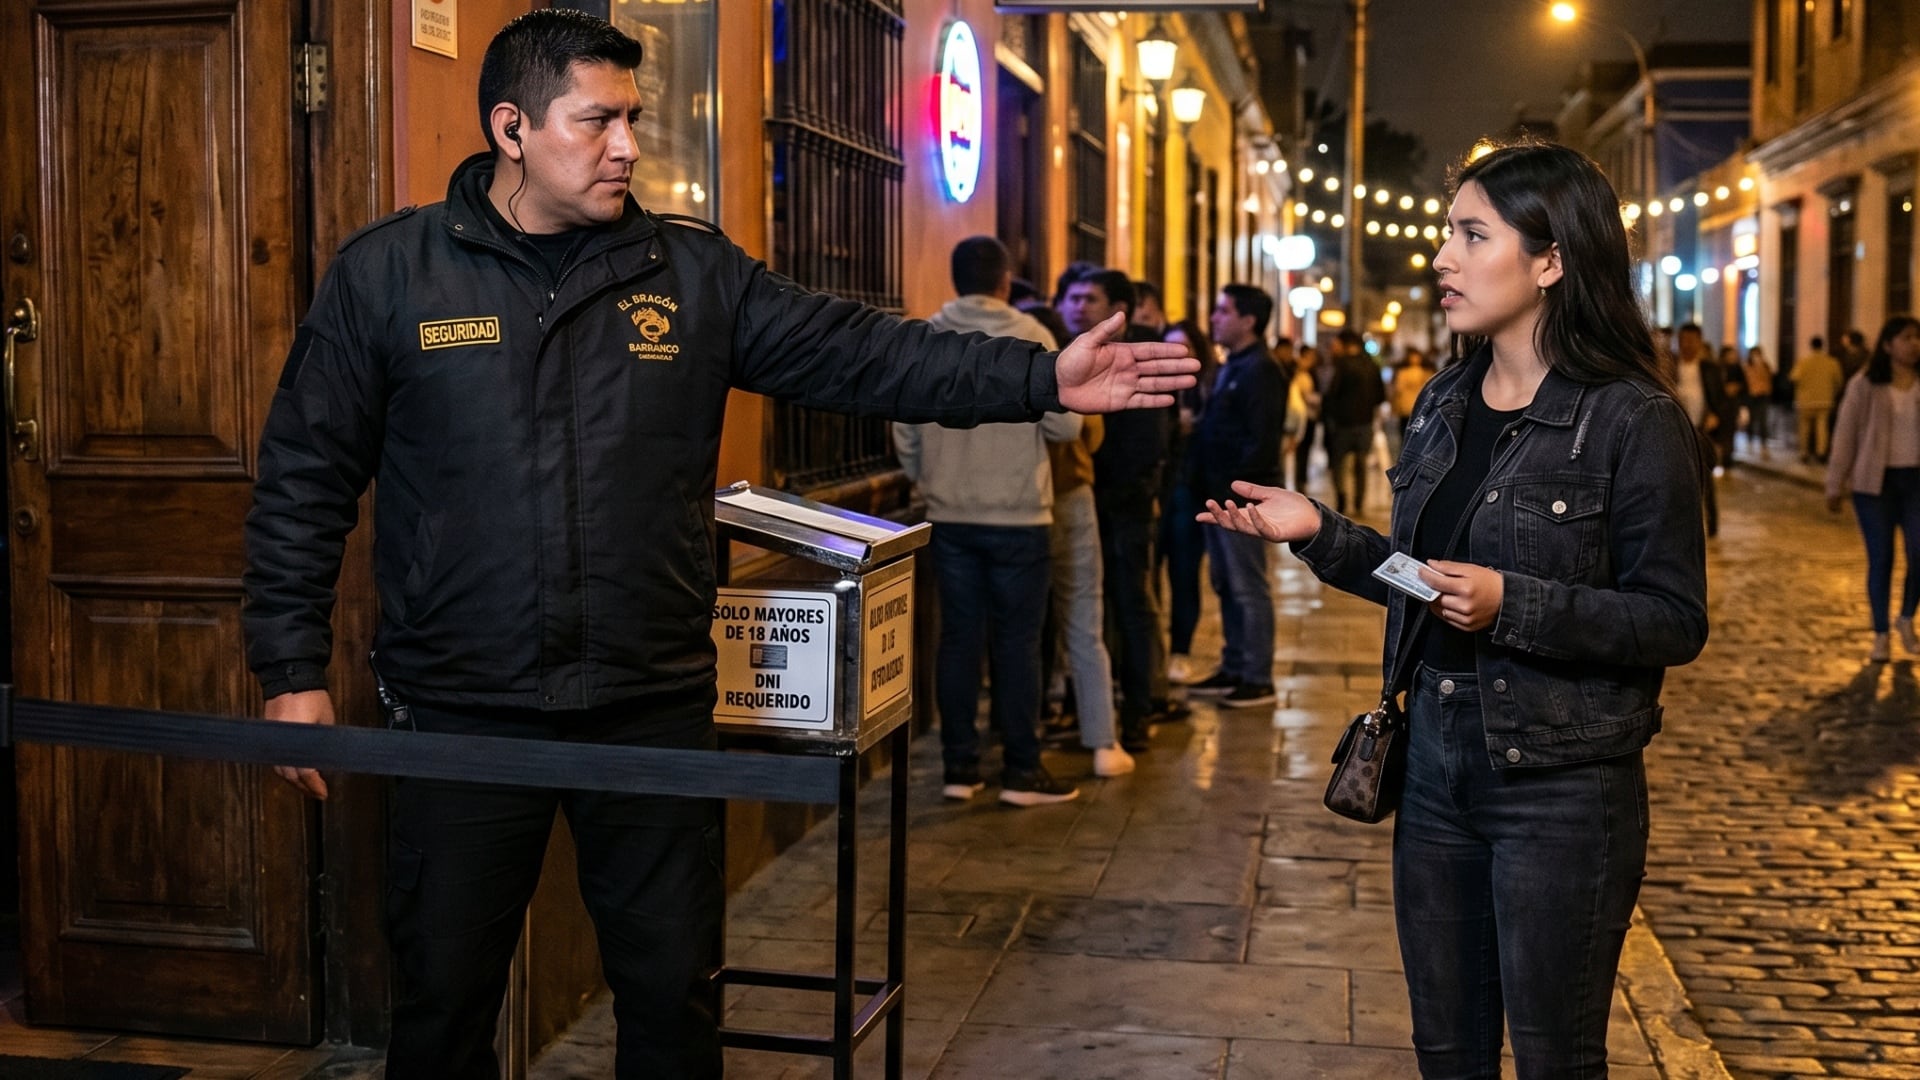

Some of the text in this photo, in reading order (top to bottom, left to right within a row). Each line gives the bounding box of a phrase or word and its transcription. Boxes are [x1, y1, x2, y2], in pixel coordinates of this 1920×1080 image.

[617, 294, 678, 313] EL BRAGÓN
[424, 321, 495, 345] SEGURIDAD
[628, 343, 680, 354] BARRANCO
[712, 603, 825, 624] SÓLO MAYORES
[725, 624, 811, 643] DE 18 AÑOS
[755, 673, 781, 689] DNI
[725, 691, 811, 709] REQUERIDO
